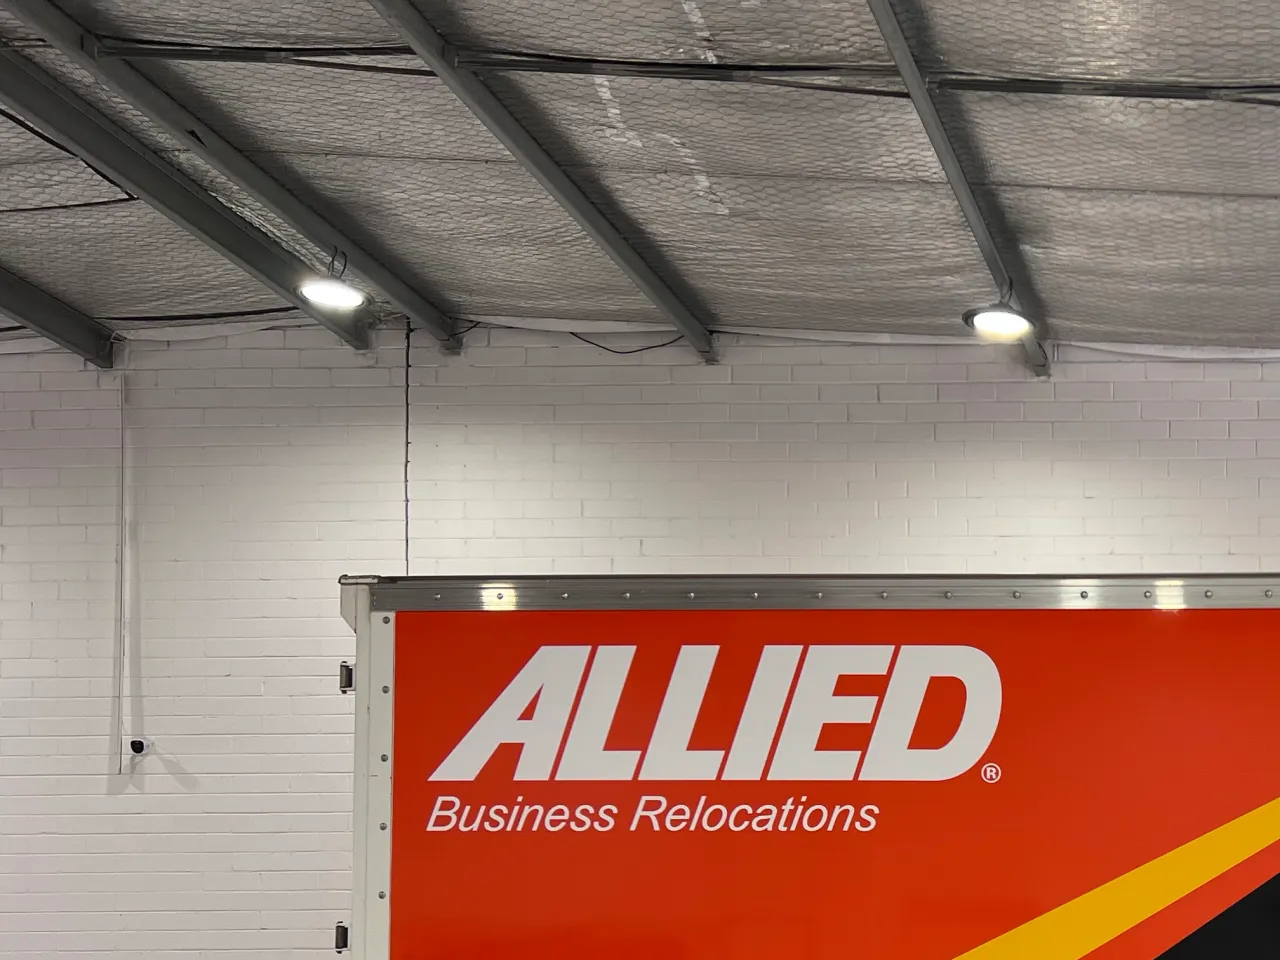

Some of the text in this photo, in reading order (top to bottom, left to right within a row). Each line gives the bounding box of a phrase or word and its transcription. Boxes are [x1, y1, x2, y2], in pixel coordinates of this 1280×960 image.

[427, 645, 1003, 781] ALLIED
[426, 795, 880, 832] Business Relocations
